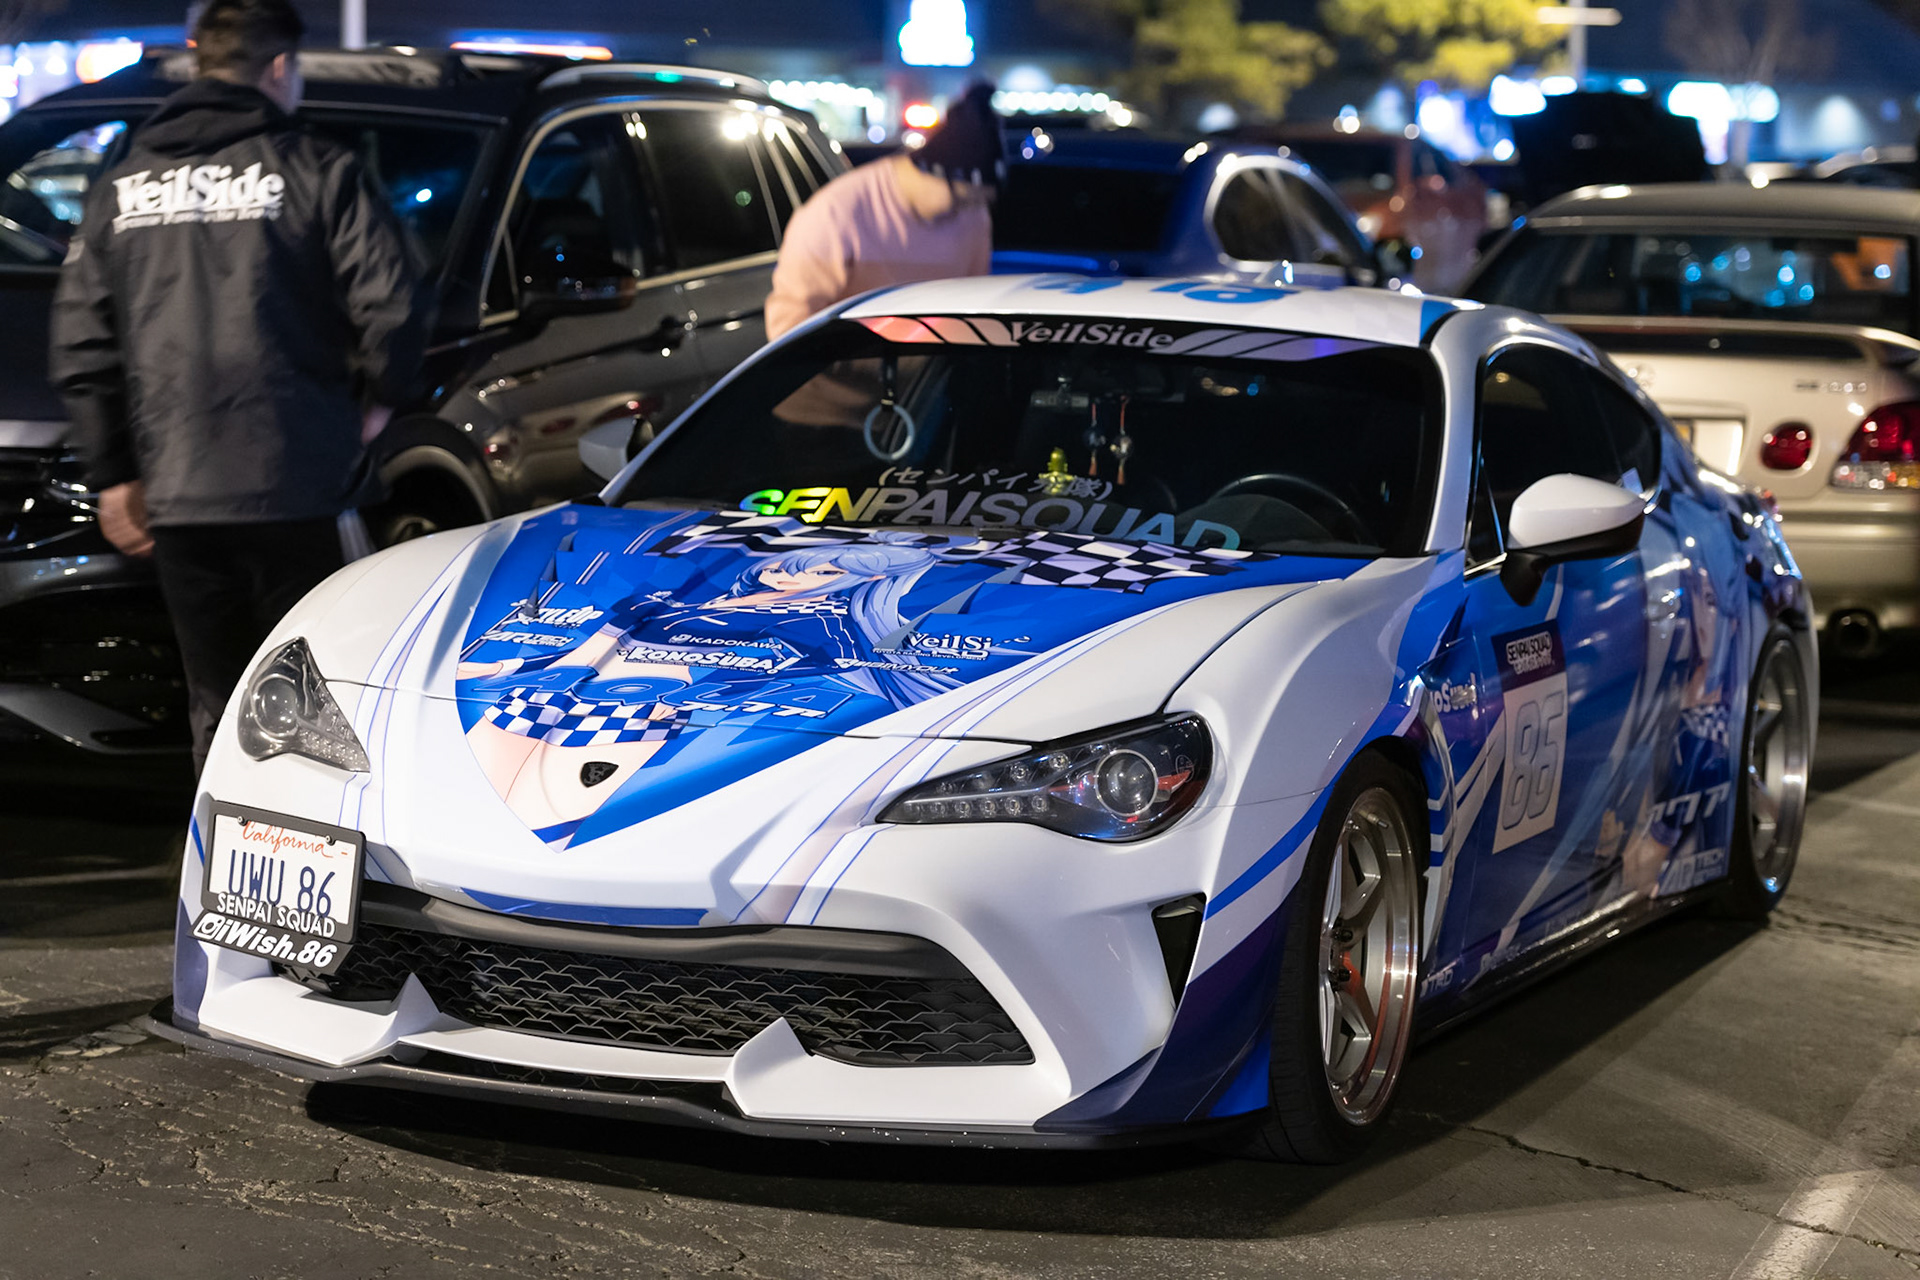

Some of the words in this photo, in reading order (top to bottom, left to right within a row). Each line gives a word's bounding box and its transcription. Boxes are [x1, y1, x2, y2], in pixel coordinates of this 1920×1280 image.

[112, 161, 286, 214] VeilSide
[1010, 321, 1176, 349] VeilSide
[689, 637, 784, 650] KADOKAWA
[932, 653, 987, 662] DEVELOPMENT
[472, 666, 854, 717] AQUA
[1502, 691, 1564, 830] 86
[242, 820, 334, 859] California
[228, 849, 285, 907] UWU
[297, 865, 336, 917] 86
[216, 891, 273, 924] SENPAI
[276, 906, 336, 939] SQUAD
[215, 918, 338, 969] iWish.86
